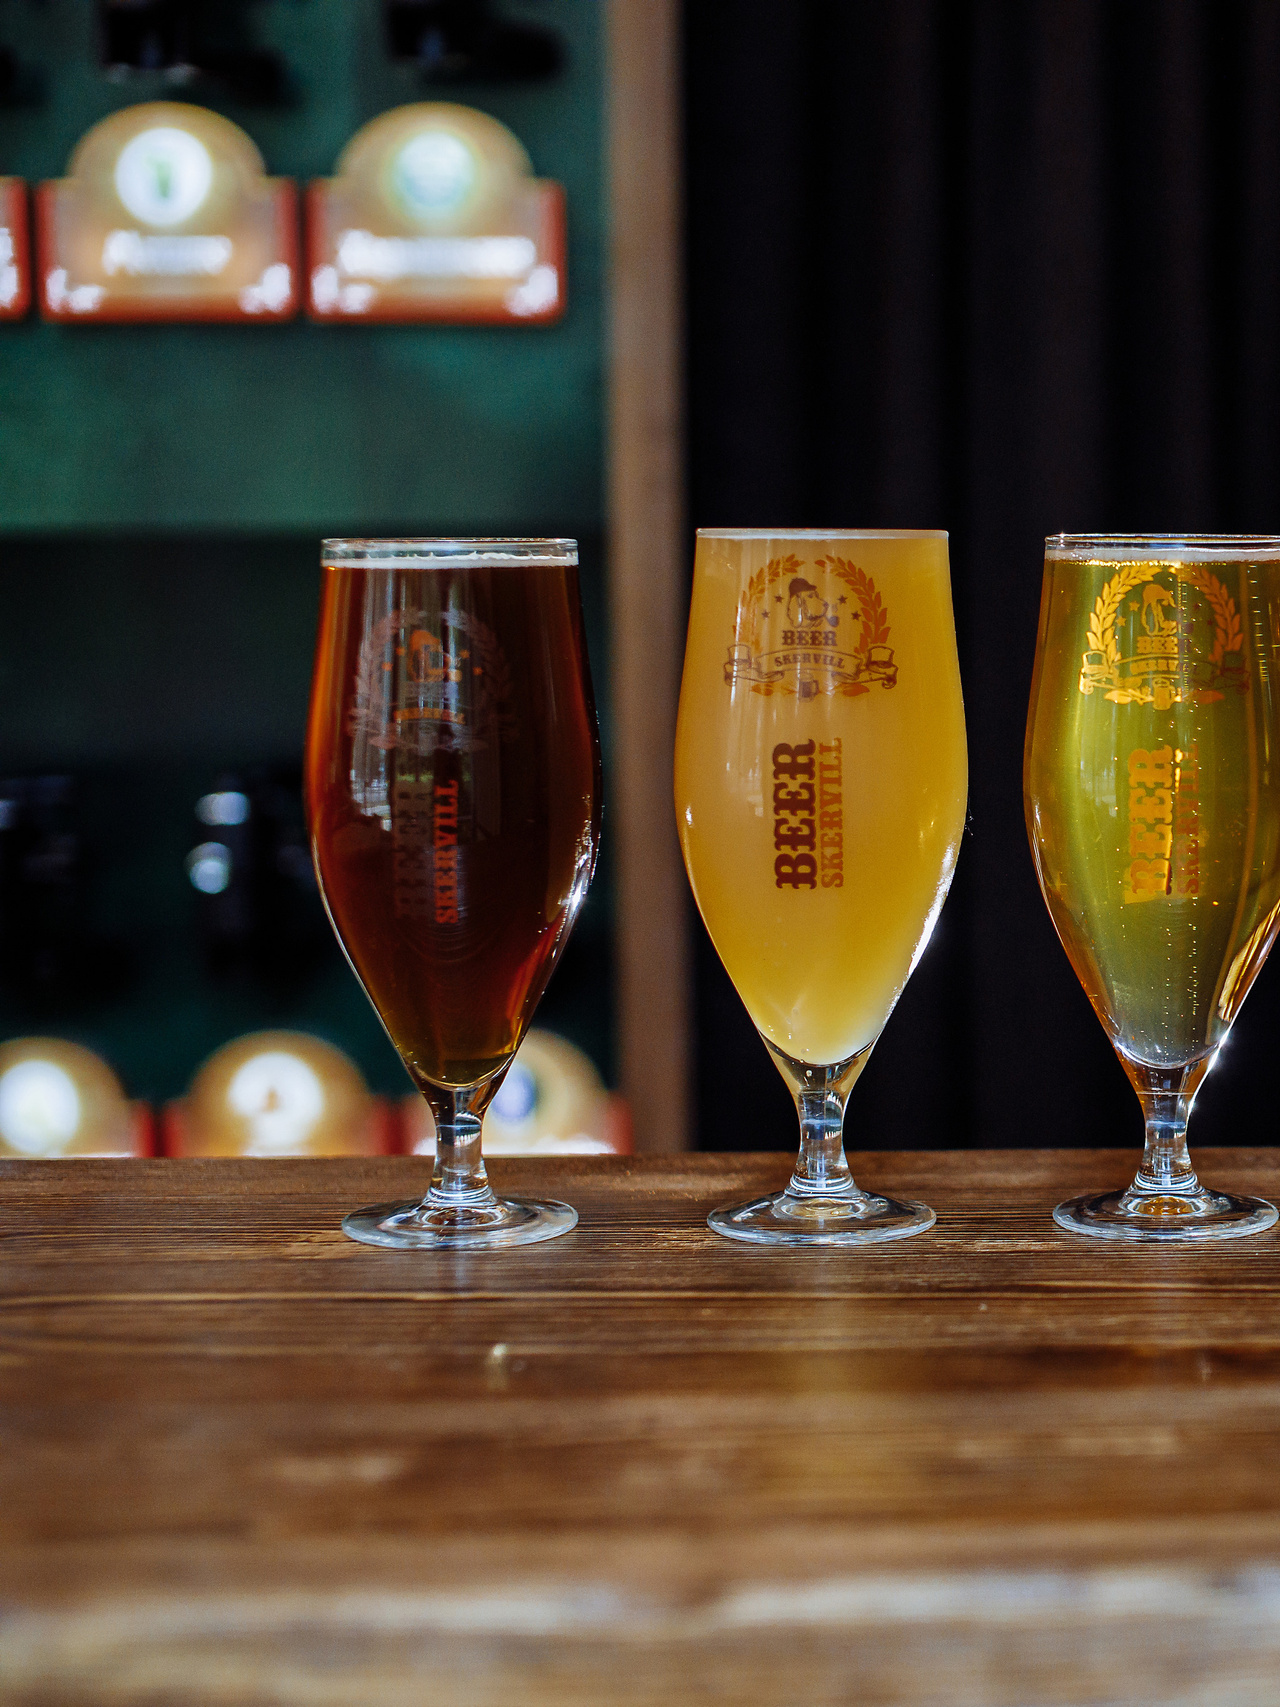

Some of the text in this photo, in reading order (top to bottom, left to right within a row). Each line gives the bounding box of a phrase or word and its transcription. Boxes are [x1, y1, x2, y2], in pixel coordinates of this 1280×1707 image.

[775, 653, 845, 668] SKERVILL
[782, 630, 837, 646] BEER
[433, 780, 458, 923] SKERVILL
[773, 738, 817, 890] BEER
[819, 737, 844, 889] SKERVILL
[1128, 744, 1172, 895] BEER
